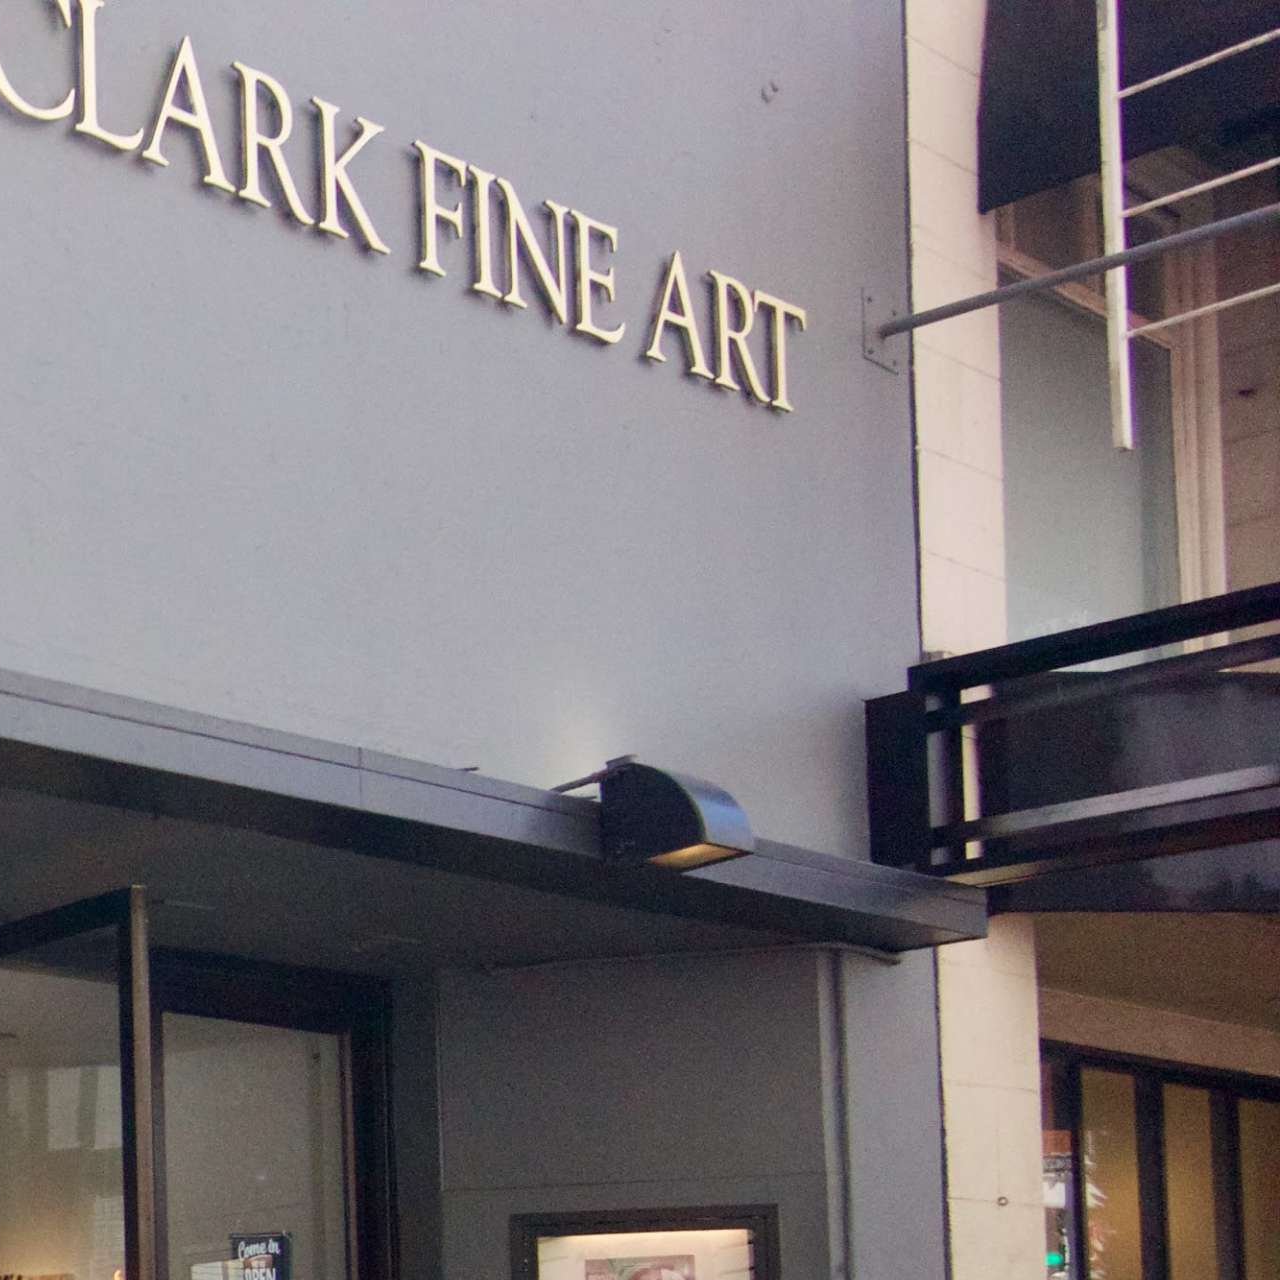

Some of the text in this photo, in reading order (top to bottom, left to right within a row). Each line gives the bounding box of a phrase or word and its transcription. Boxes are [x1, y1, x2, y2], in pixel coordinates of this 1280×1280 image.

[414, 139, 626, 344] FINE
[645, 249, 807, 412] ART
[238, 1241, 267, 1259] Come
